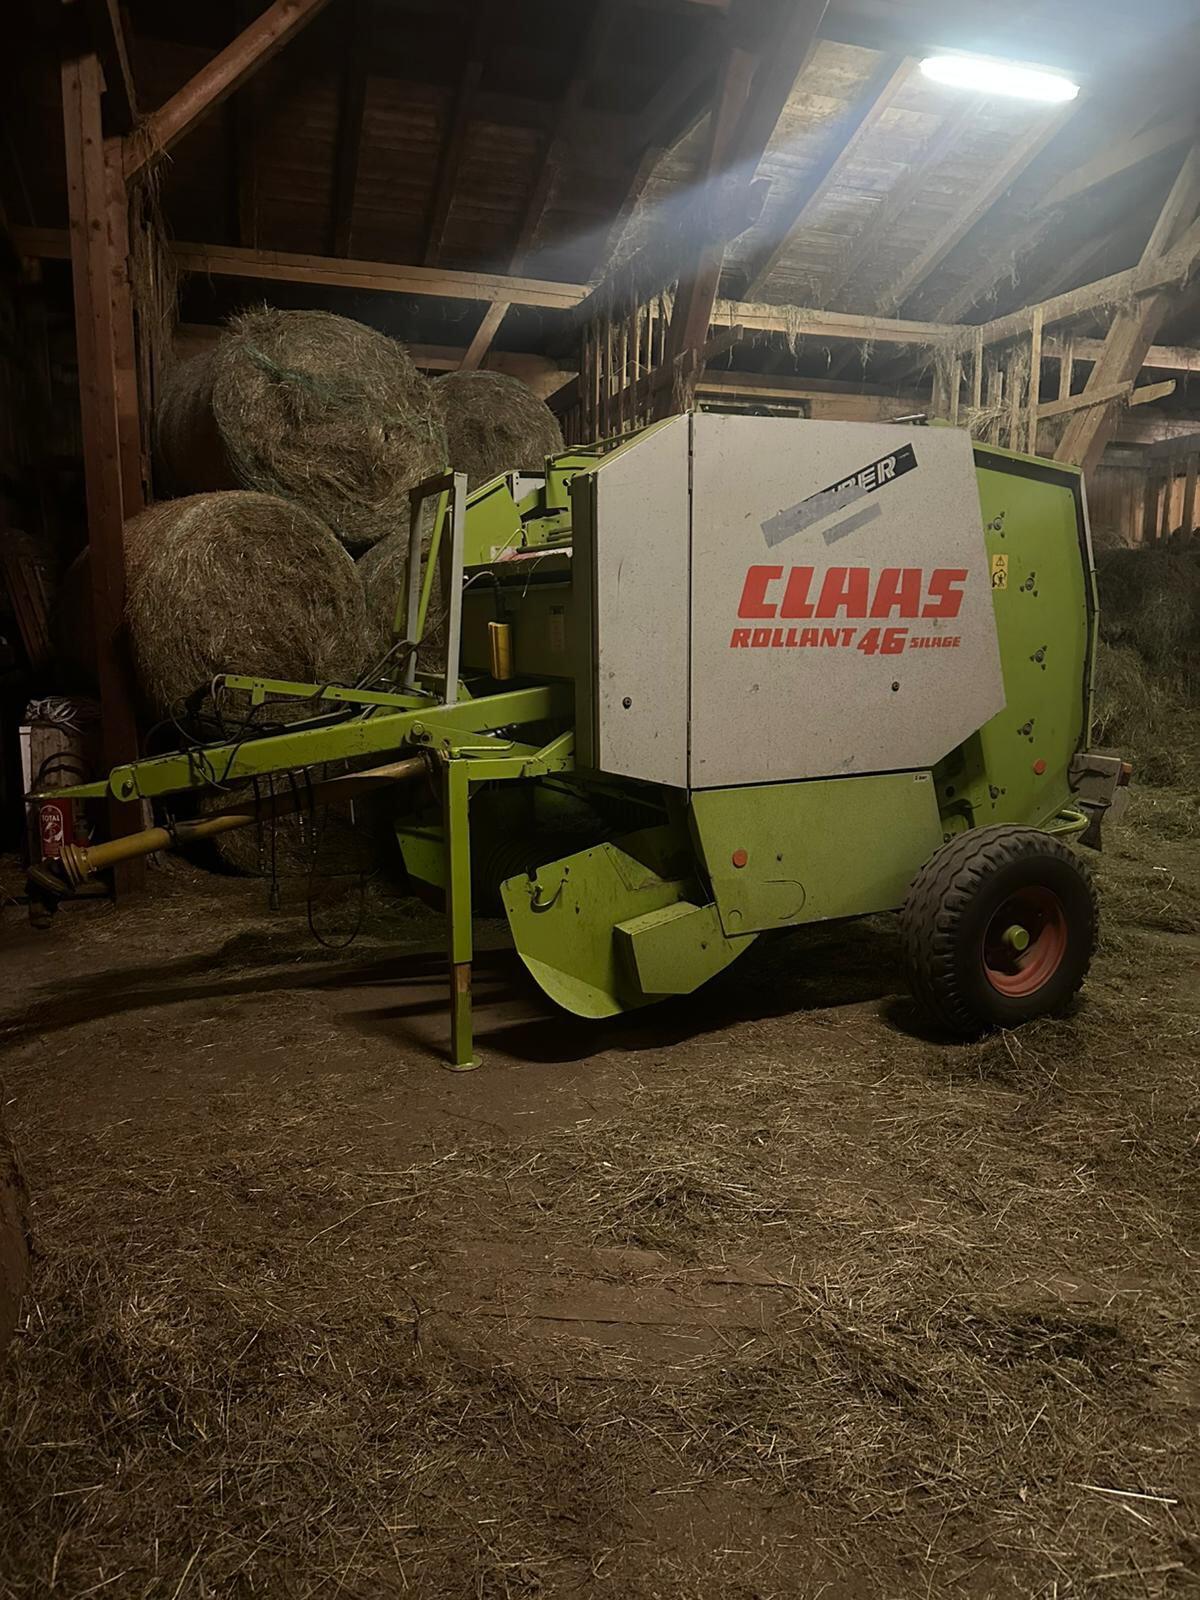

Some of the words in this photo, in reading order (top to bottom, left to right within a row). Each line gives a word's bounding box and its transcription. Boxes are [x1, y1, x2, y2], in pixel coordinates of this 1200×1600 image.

[737, 565, 968, 619] CLAAS
[730, 628, 857, 648] ROLLANT
[857, 627, 909, 655] 46
[909, 636, 961, 648] SILAGE
[41, 815, 60, 823] TOTAL
